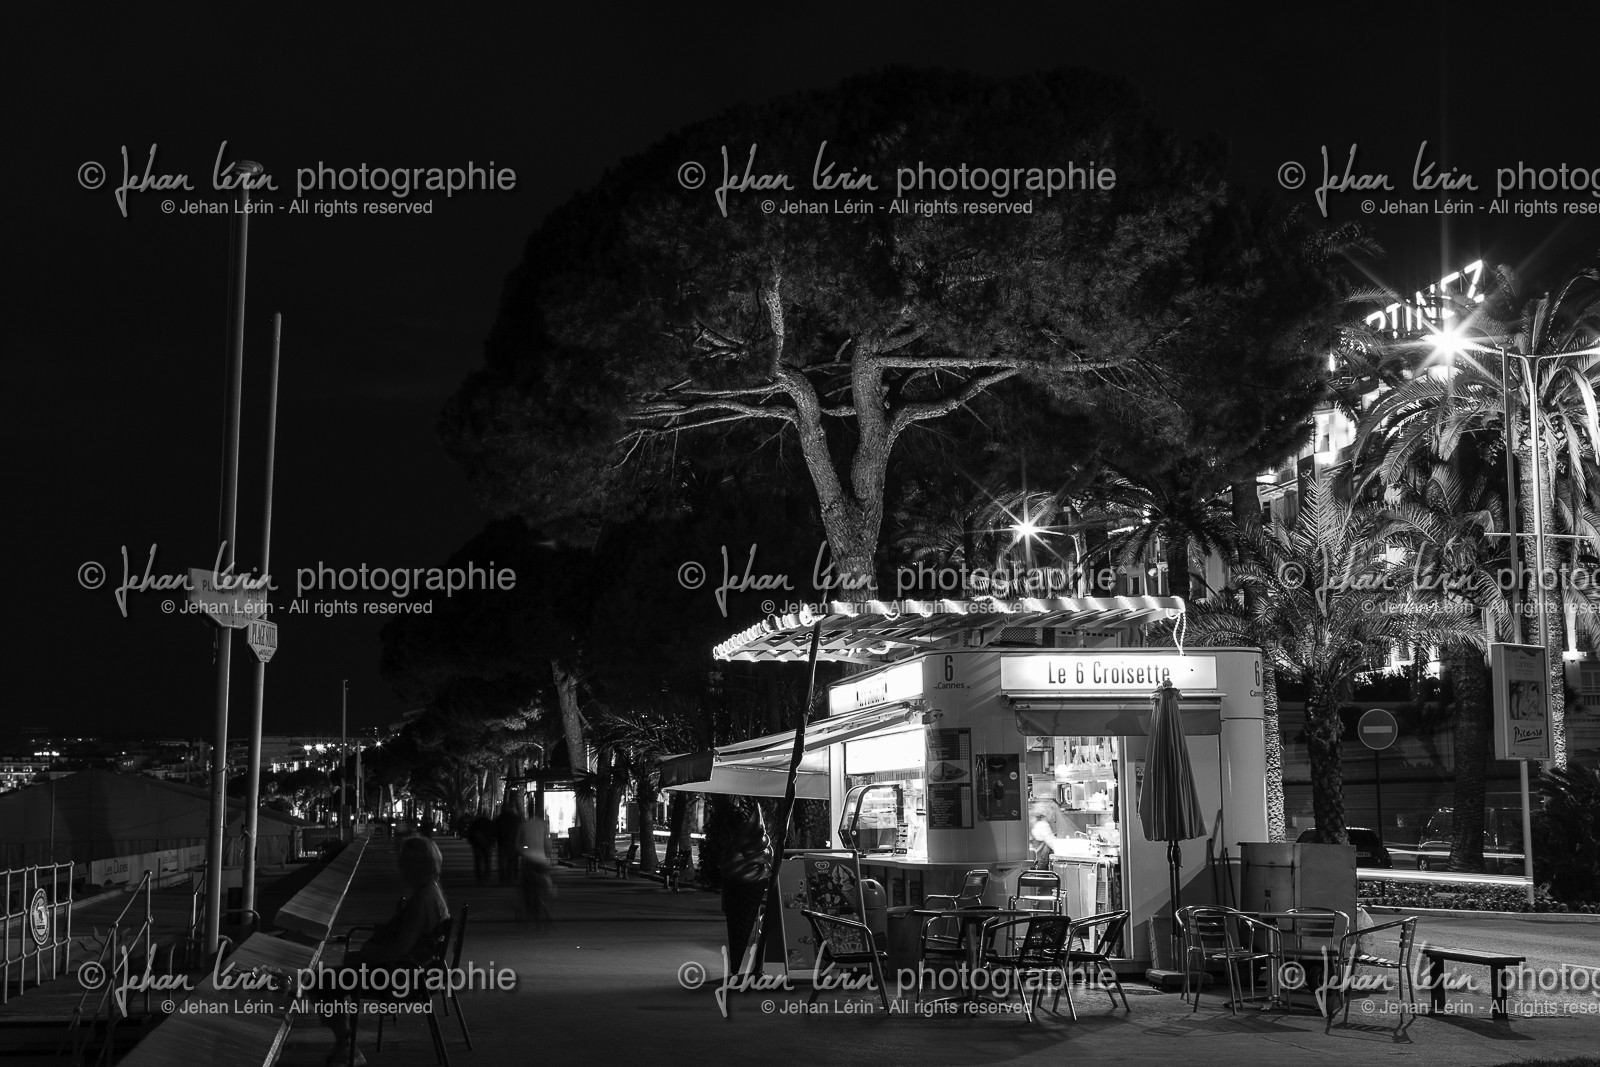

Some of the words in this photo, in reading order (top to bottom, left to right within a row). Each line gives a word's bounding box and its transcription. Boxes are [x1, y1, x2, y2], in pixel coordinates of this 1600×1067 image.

[203, 580, 226, 594] PLAE
[945, 655, 953, 681] 6
[1048, 661, 1066, 684] Le
[1076, 661, 1084, 684] 6
[1093, 661, 1170, 684] Croisette
[1255, 661, 1261, 687] 6
[1513, 726, 1543, 746] Picasso
[104, 861, 113, 876] Les
[114, 860, 128, 874] Dunes
